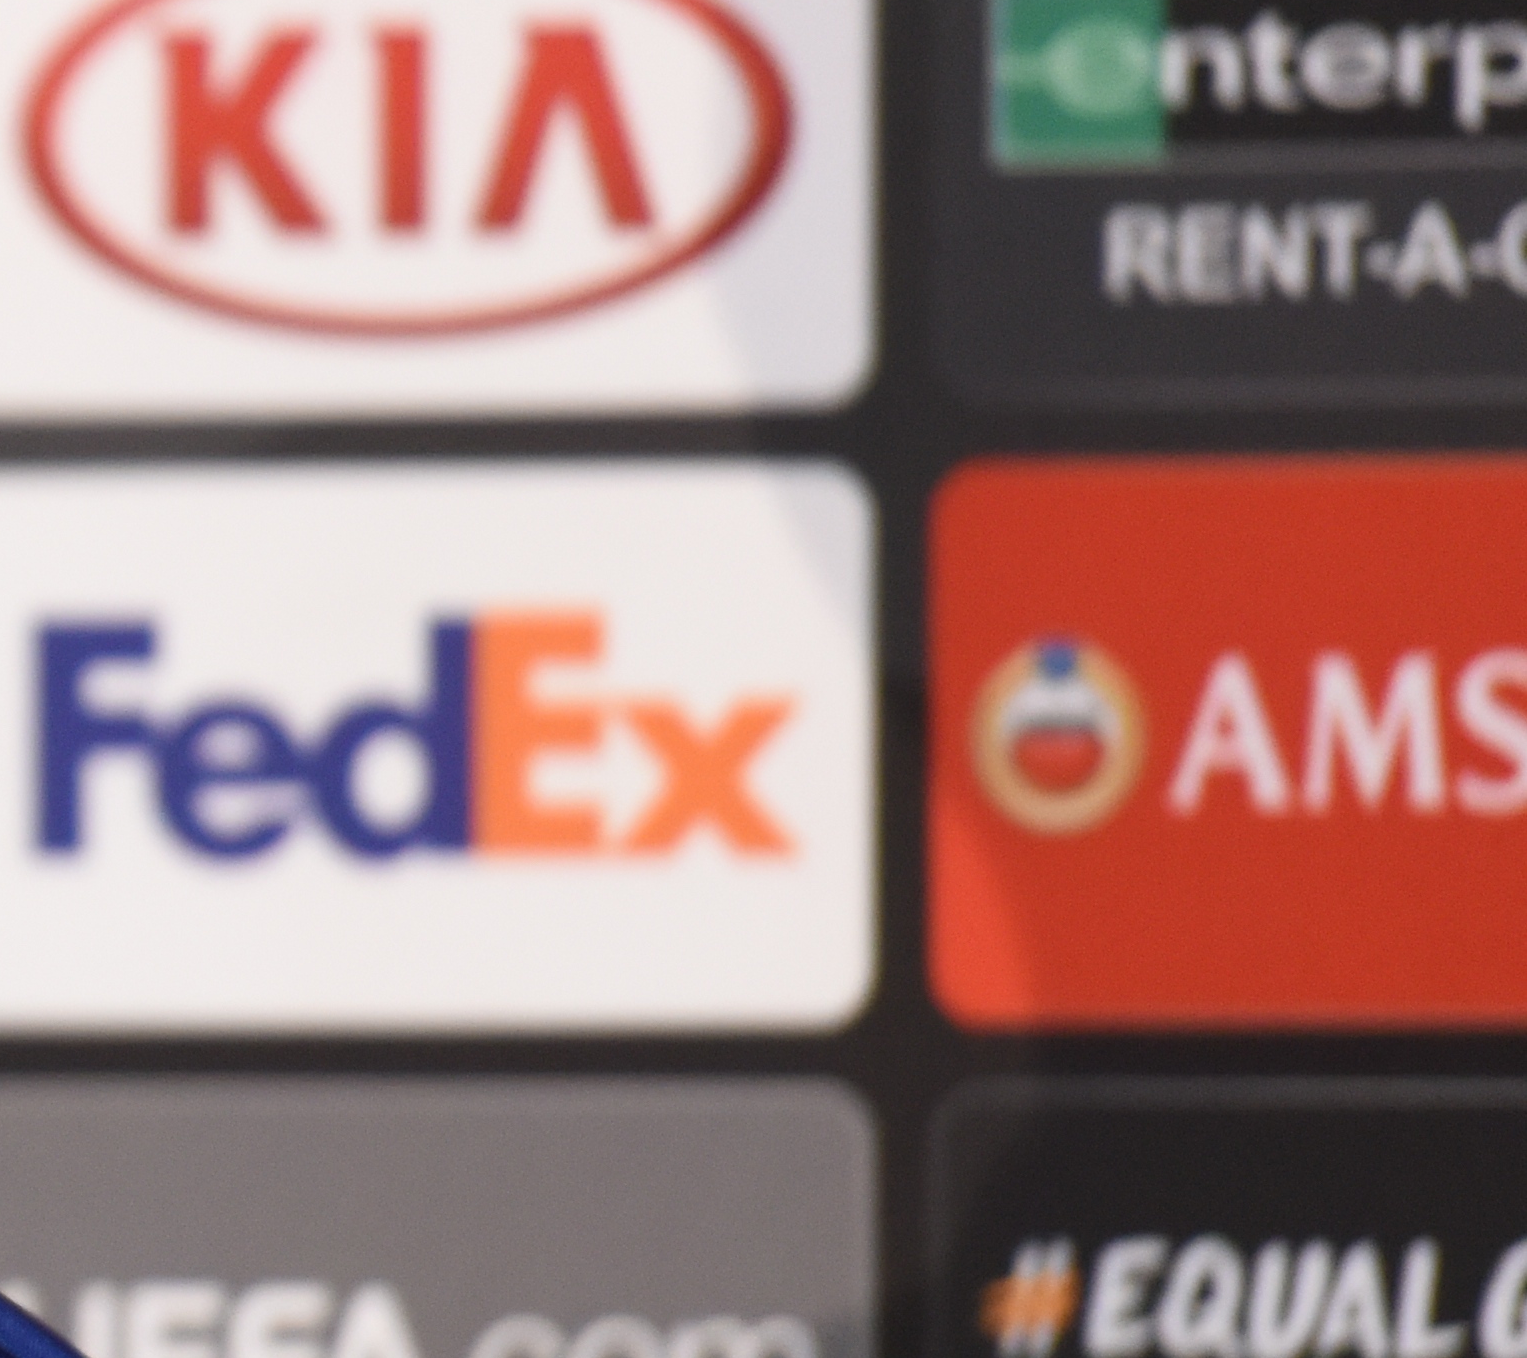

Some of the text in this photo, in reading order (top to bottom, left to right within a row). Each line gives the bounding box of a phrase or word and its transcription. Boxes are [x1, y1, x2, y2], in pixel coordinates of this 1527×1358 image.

[154, 16, 659, 241] KIA
[1009, 8, 1527, 135] enterp
[27, 608, 801, 867] FedEx
[1167, 646, 1527, 817] AMS
